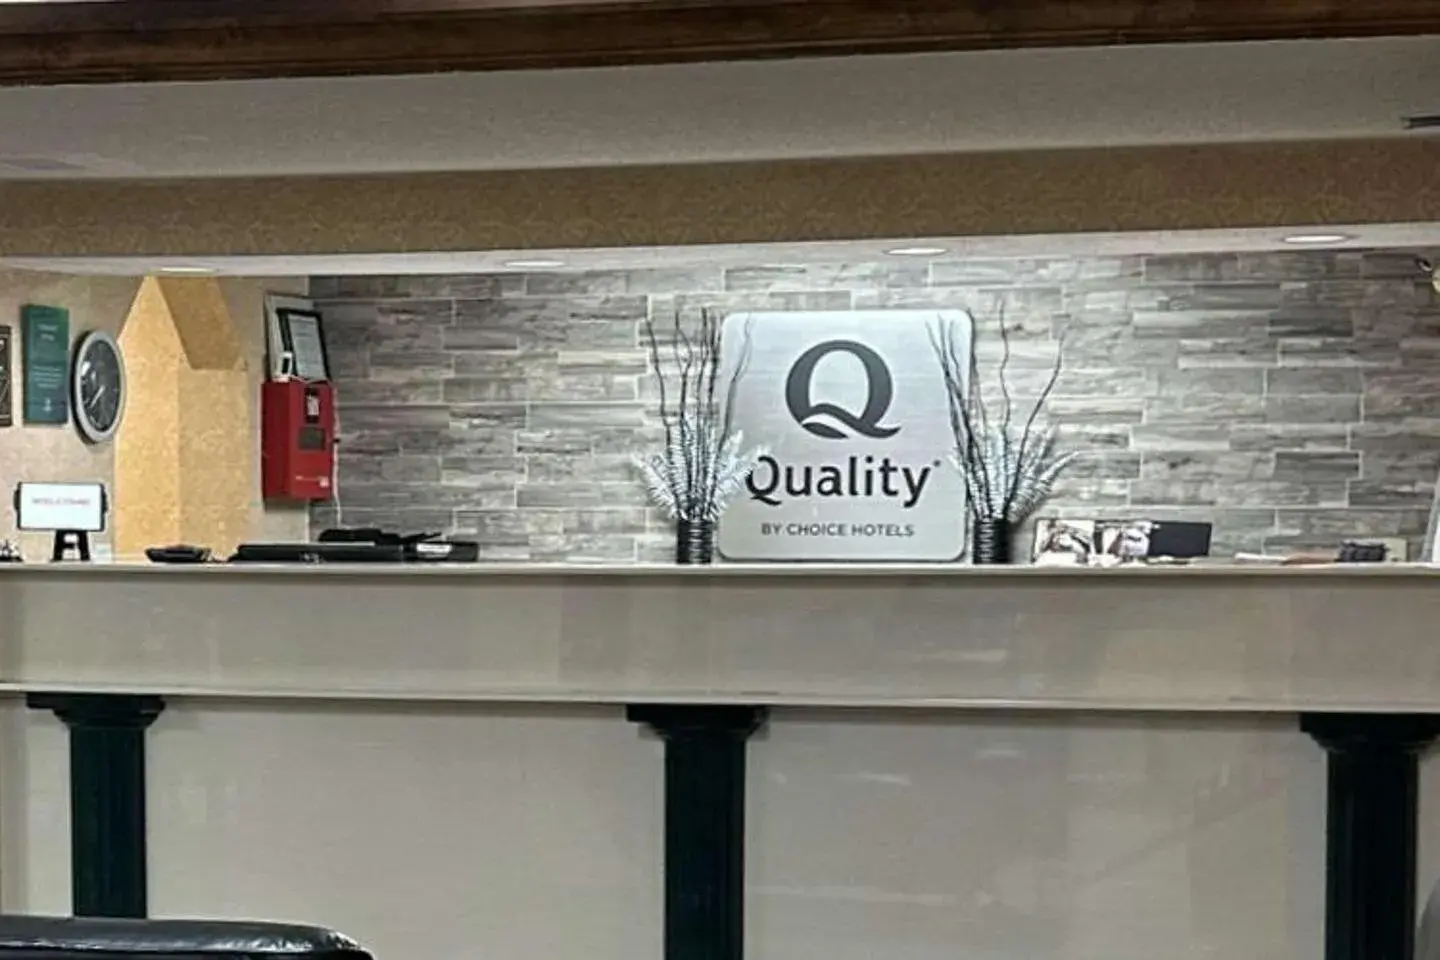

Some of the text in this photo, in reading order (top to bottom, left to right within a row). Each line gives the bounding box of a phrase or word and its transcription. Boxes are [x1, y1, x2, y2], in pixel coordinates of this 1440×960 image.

[785, 339, 901, 439] Q
[745, 455, 931, 508] Quality
[761, 523, 915, 536] BY CHOICE HOTELS
